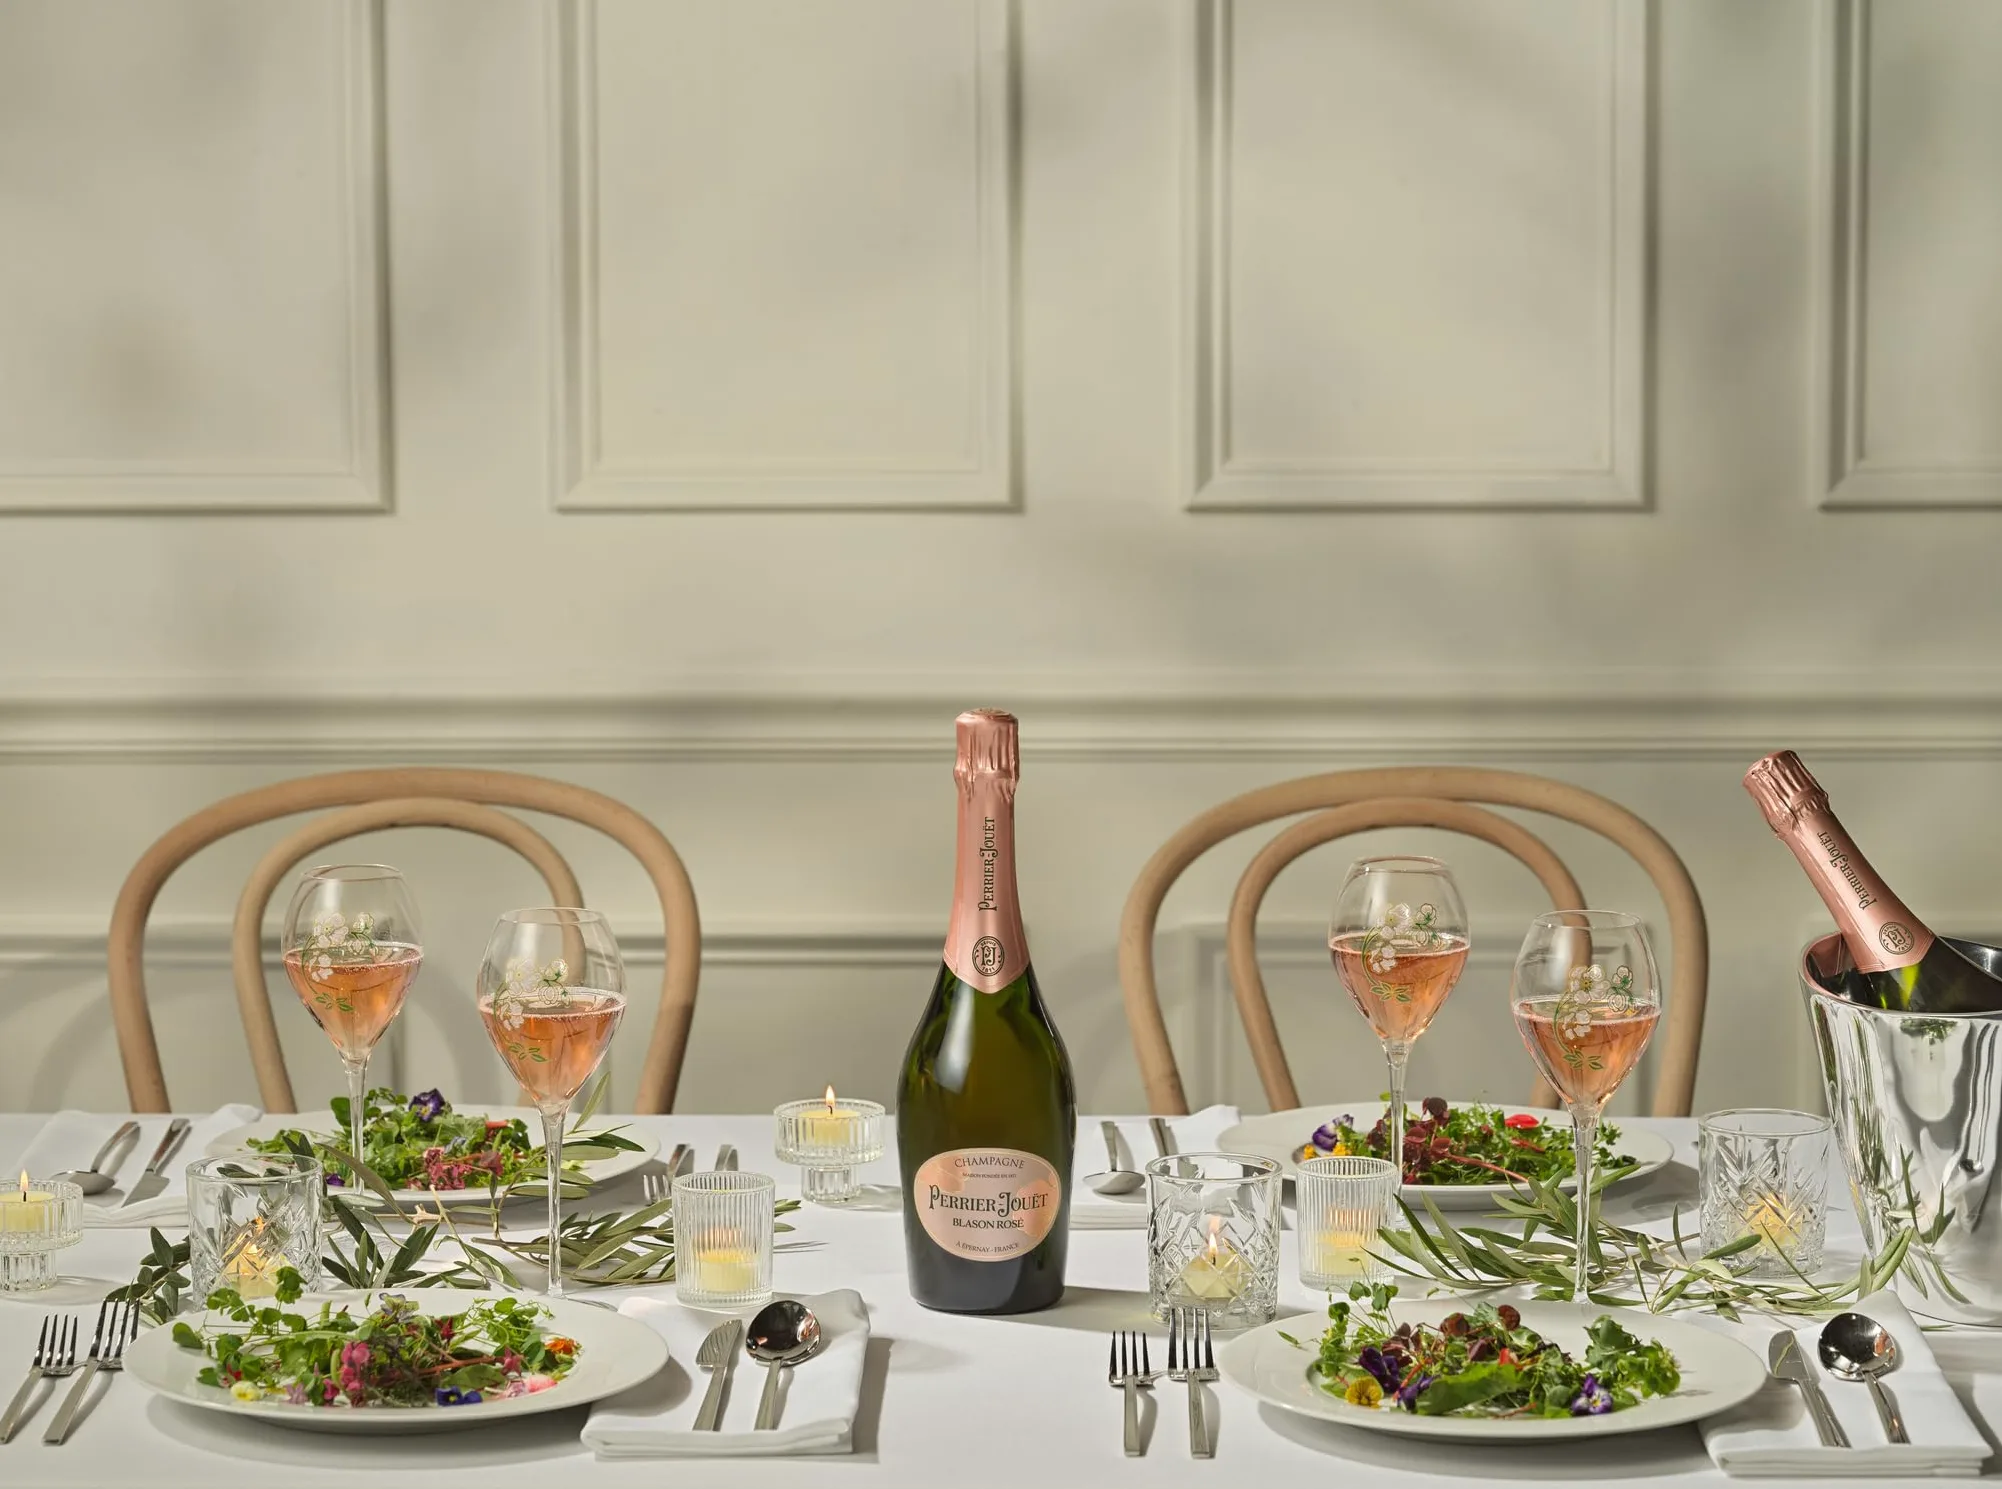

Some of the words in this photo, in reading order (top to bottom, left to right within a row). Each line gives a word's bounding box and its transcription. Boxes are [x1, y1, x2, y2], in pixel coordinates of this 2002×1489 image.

[978, 816, 999, 911] PERRIER-JOUËT
[1817, 831, 1877, 910] PERRIER-JOUËT
[954, 1156, 1025, 1169] CHAMPAGNE
[928, 1184, 1049, 1217] PERRIER-JOUËT
[952, 1217, 995, 1229] BLASON
[996, 1216, 1024, 1229] ROSÉ
